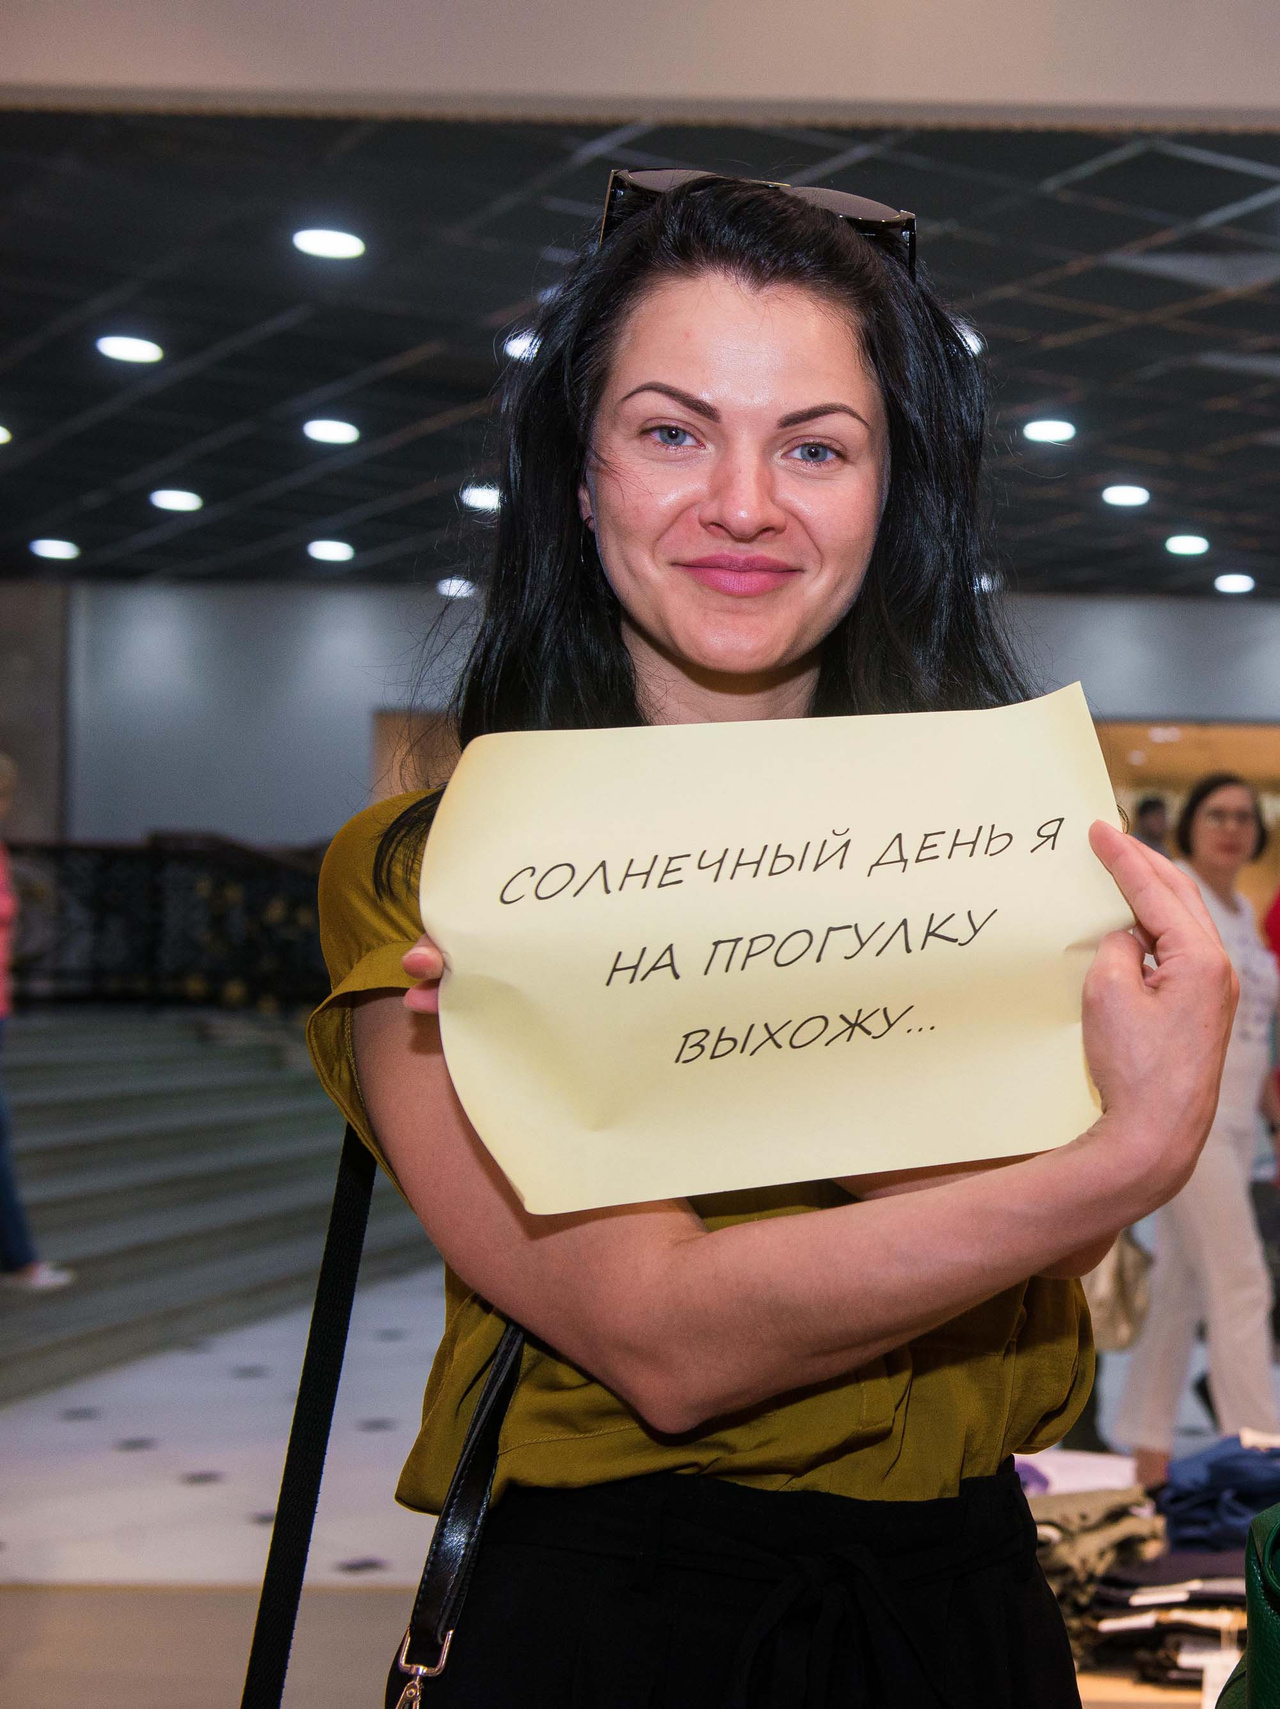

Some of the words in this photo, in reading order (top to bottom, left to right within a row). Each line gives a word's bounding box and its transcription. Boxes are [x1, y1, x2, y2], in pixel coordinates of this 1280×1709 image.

[499, 827, 852, 905] СОЛНЕЧНЫЙ
[866, 823, 1014, 878] ДЕНЬ
[1029, 817, 1065, 854] Я
[605, 943, 682, 987] НА
[703, 908, 998, 977] ПРОГУЛКУ
[674, 1004, 936, 1064] ВЫХОЖУ...
